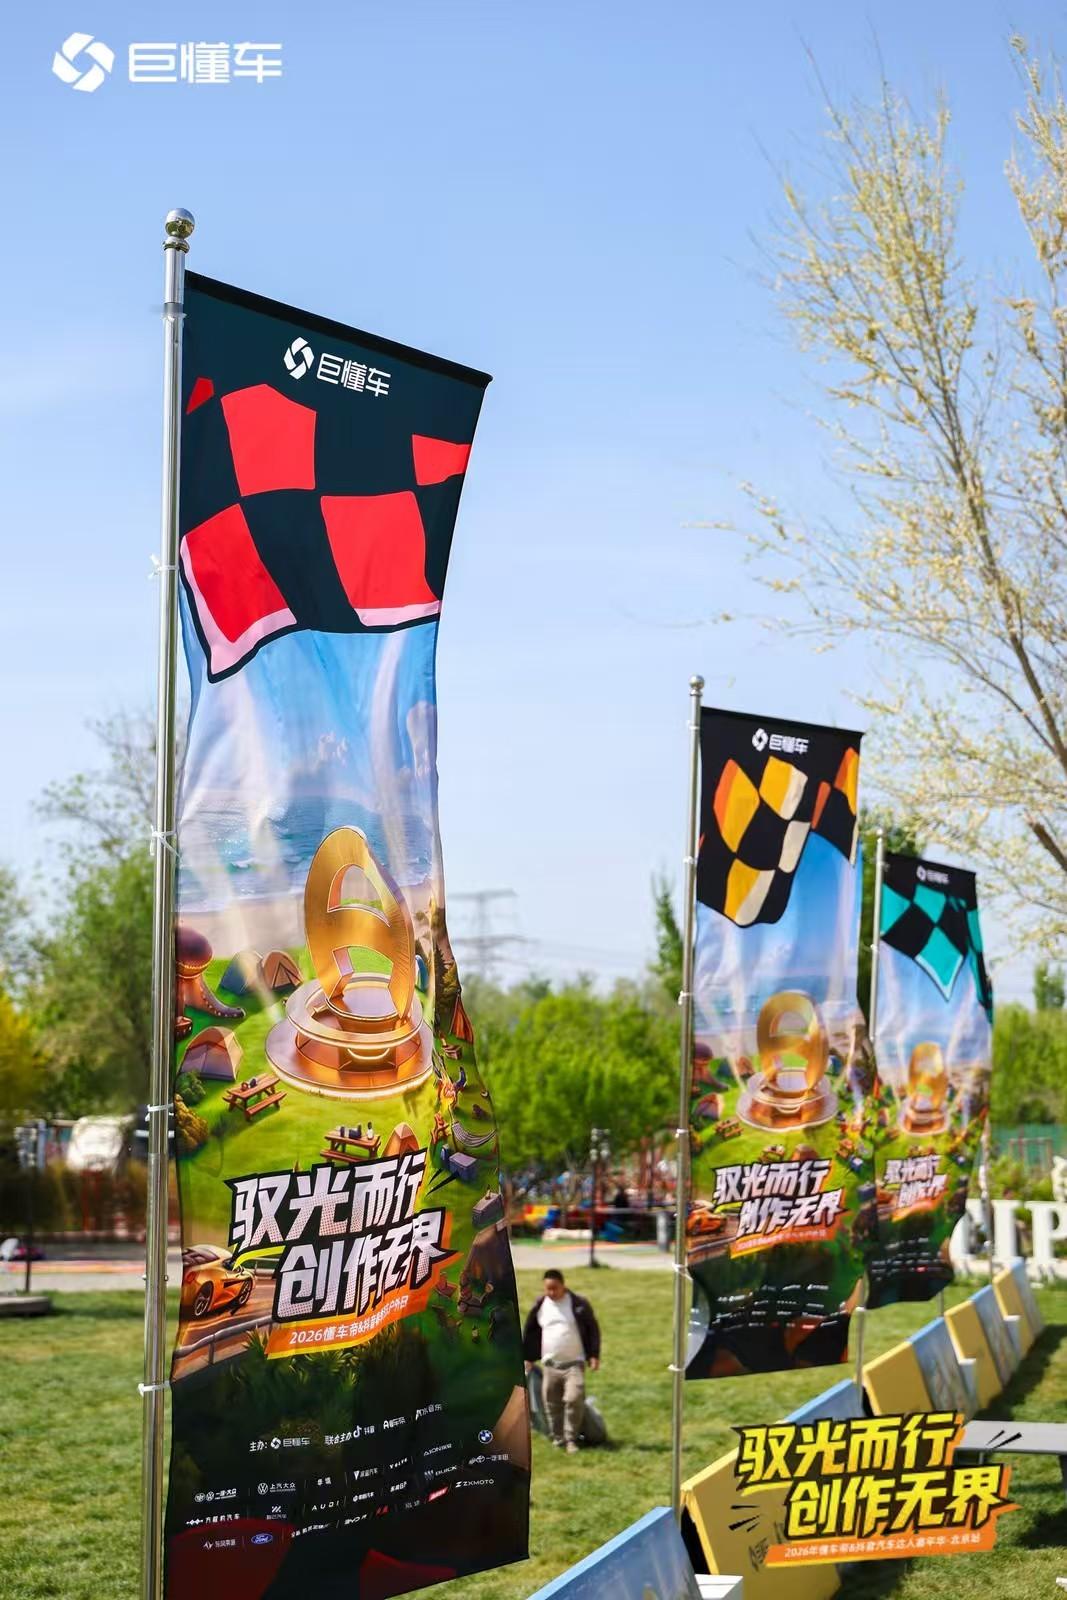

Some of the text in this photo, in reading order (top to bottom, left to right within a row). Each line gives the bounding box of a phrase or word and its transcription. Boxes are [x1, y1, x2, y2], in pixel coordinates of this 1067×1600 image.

[316, 352, 392, 397] 巨懂车
[232, 1151, 426, 1252] 驭光而行
[714, 1159, 832, 1205] 驭光而行
[276, 1210, 446, 1319] 创作无界
[269, 1482, 296, 1490] 上汽大众
[463, 1478, 495, 1487] ZXMOTO
